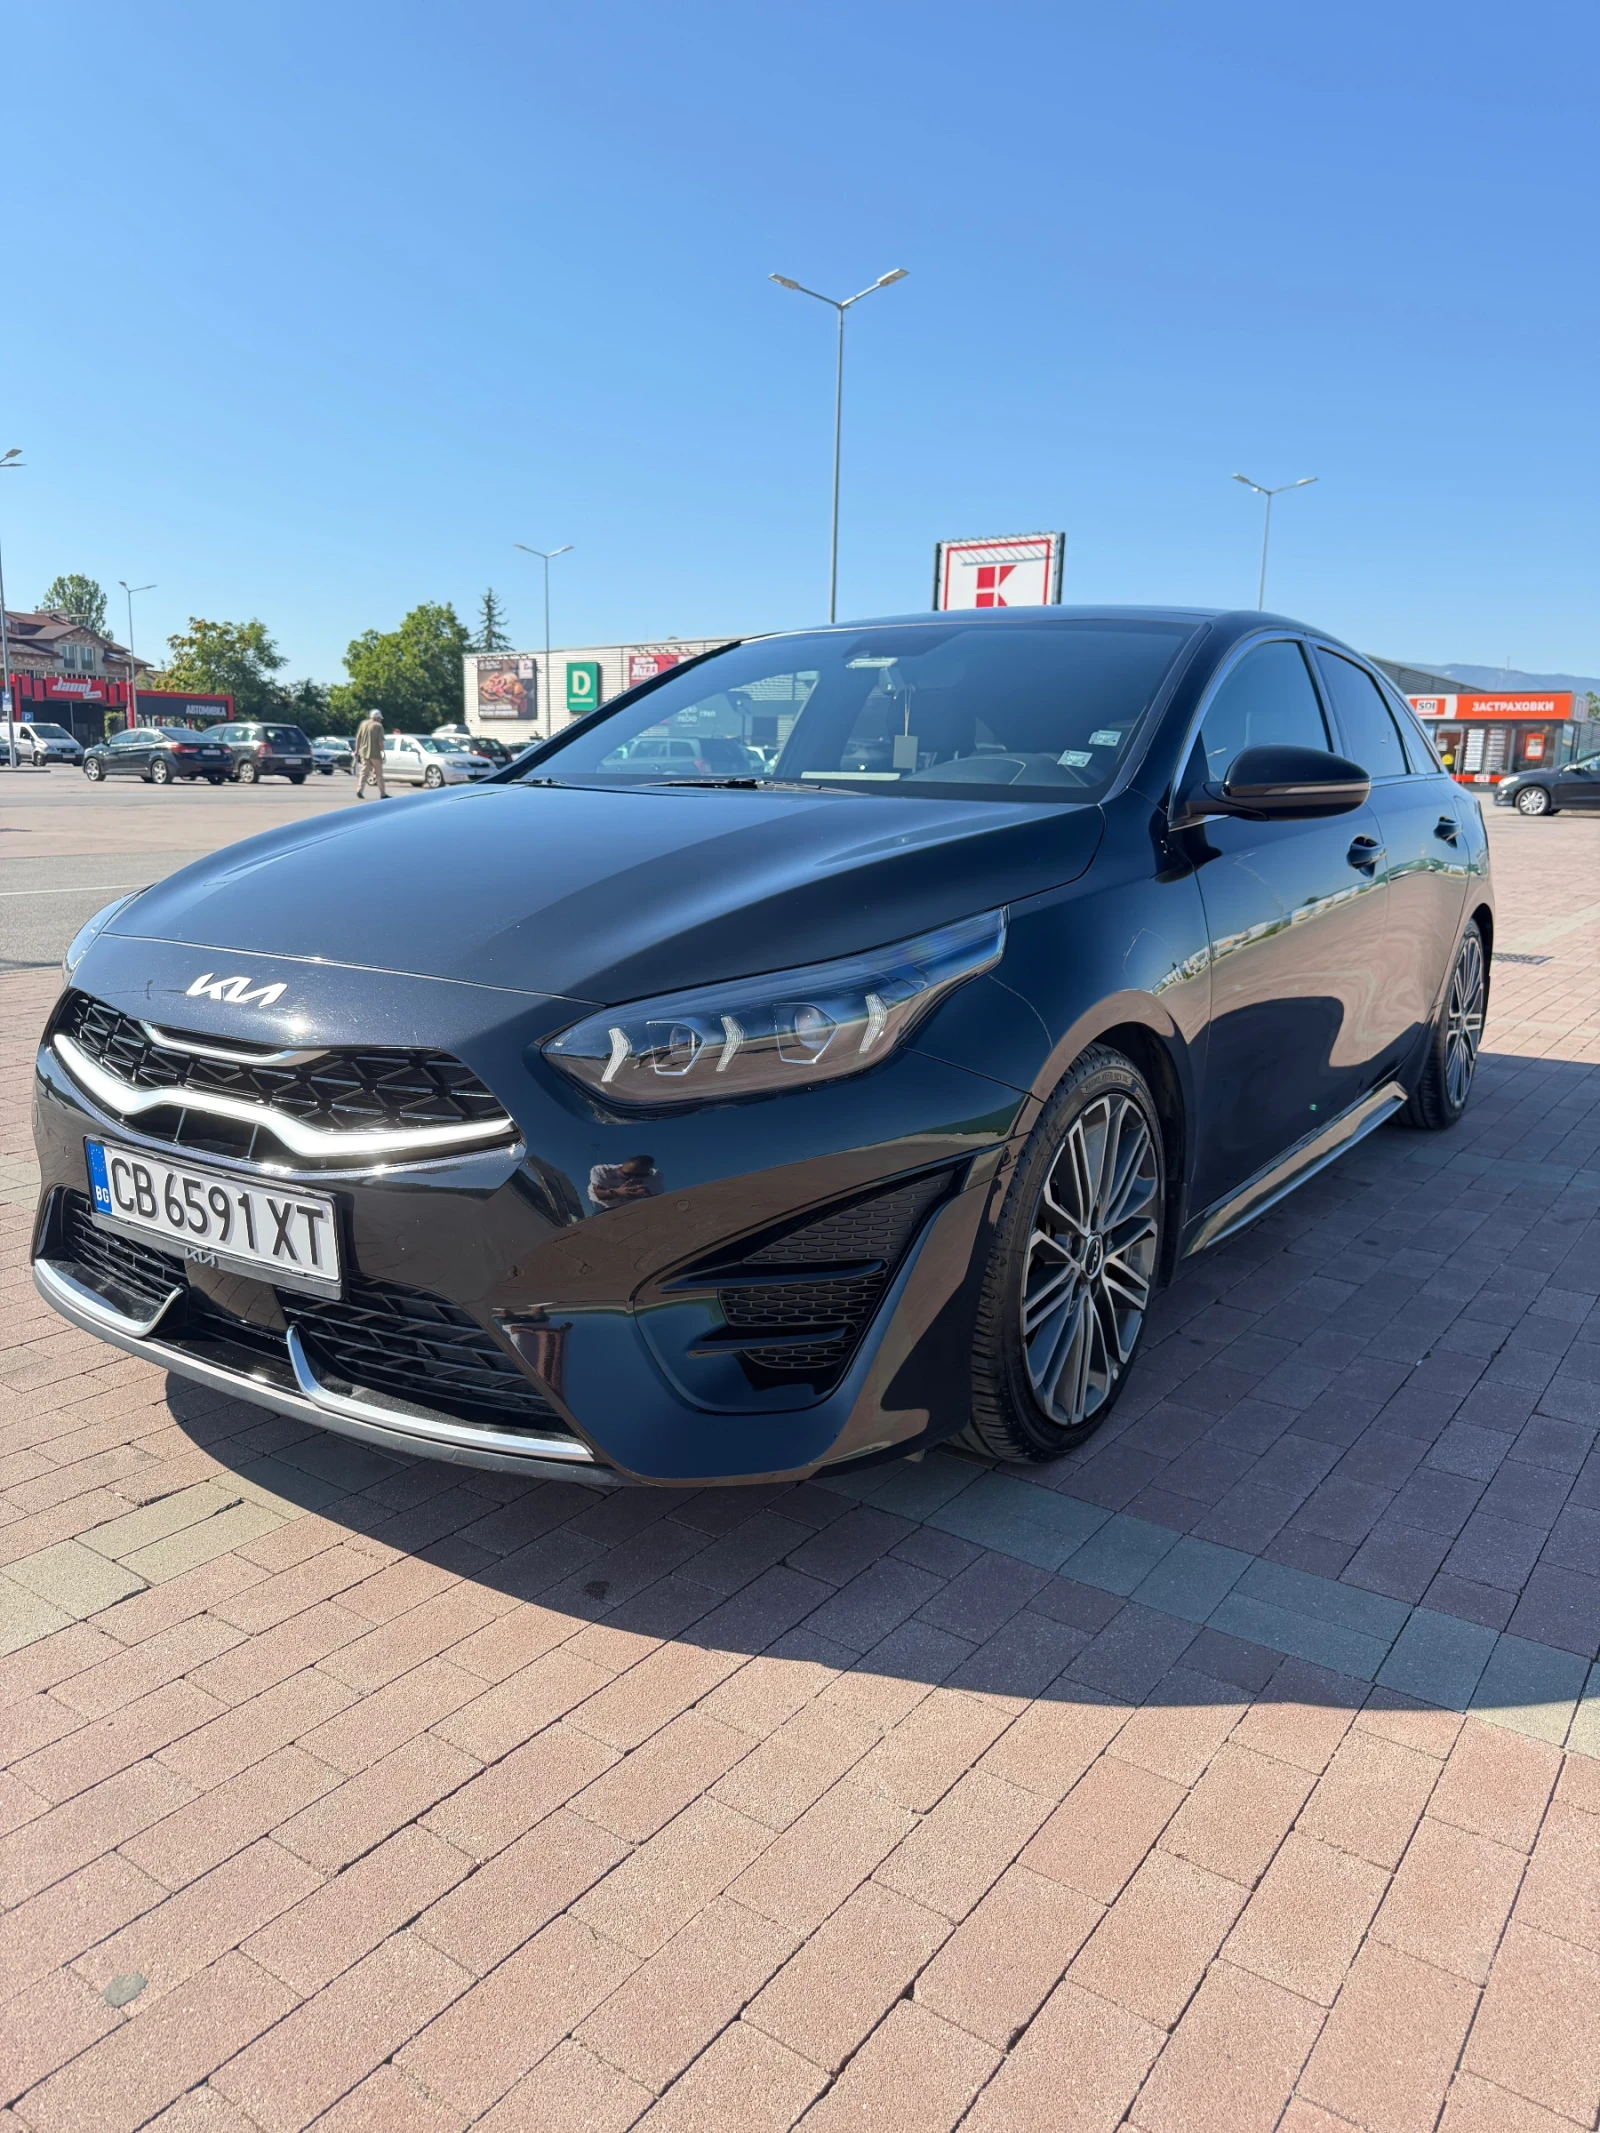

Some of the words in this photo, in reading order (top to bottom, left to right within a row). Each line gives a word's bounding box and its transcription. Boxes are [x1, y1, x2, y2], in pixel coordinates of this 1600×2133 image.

[976, 564, 1017, 608] K
[572, 670, 591, 696] D
[185, 704, 227, 717] АВТОМИВКА
[1418, 701, 1436, 711] SDI
[1471, 700, 1555, 713] ЗАСТРАХОВКИ
[186, 972, 288, 1009] KIA
[95, 1185, 110, 1204] BG
